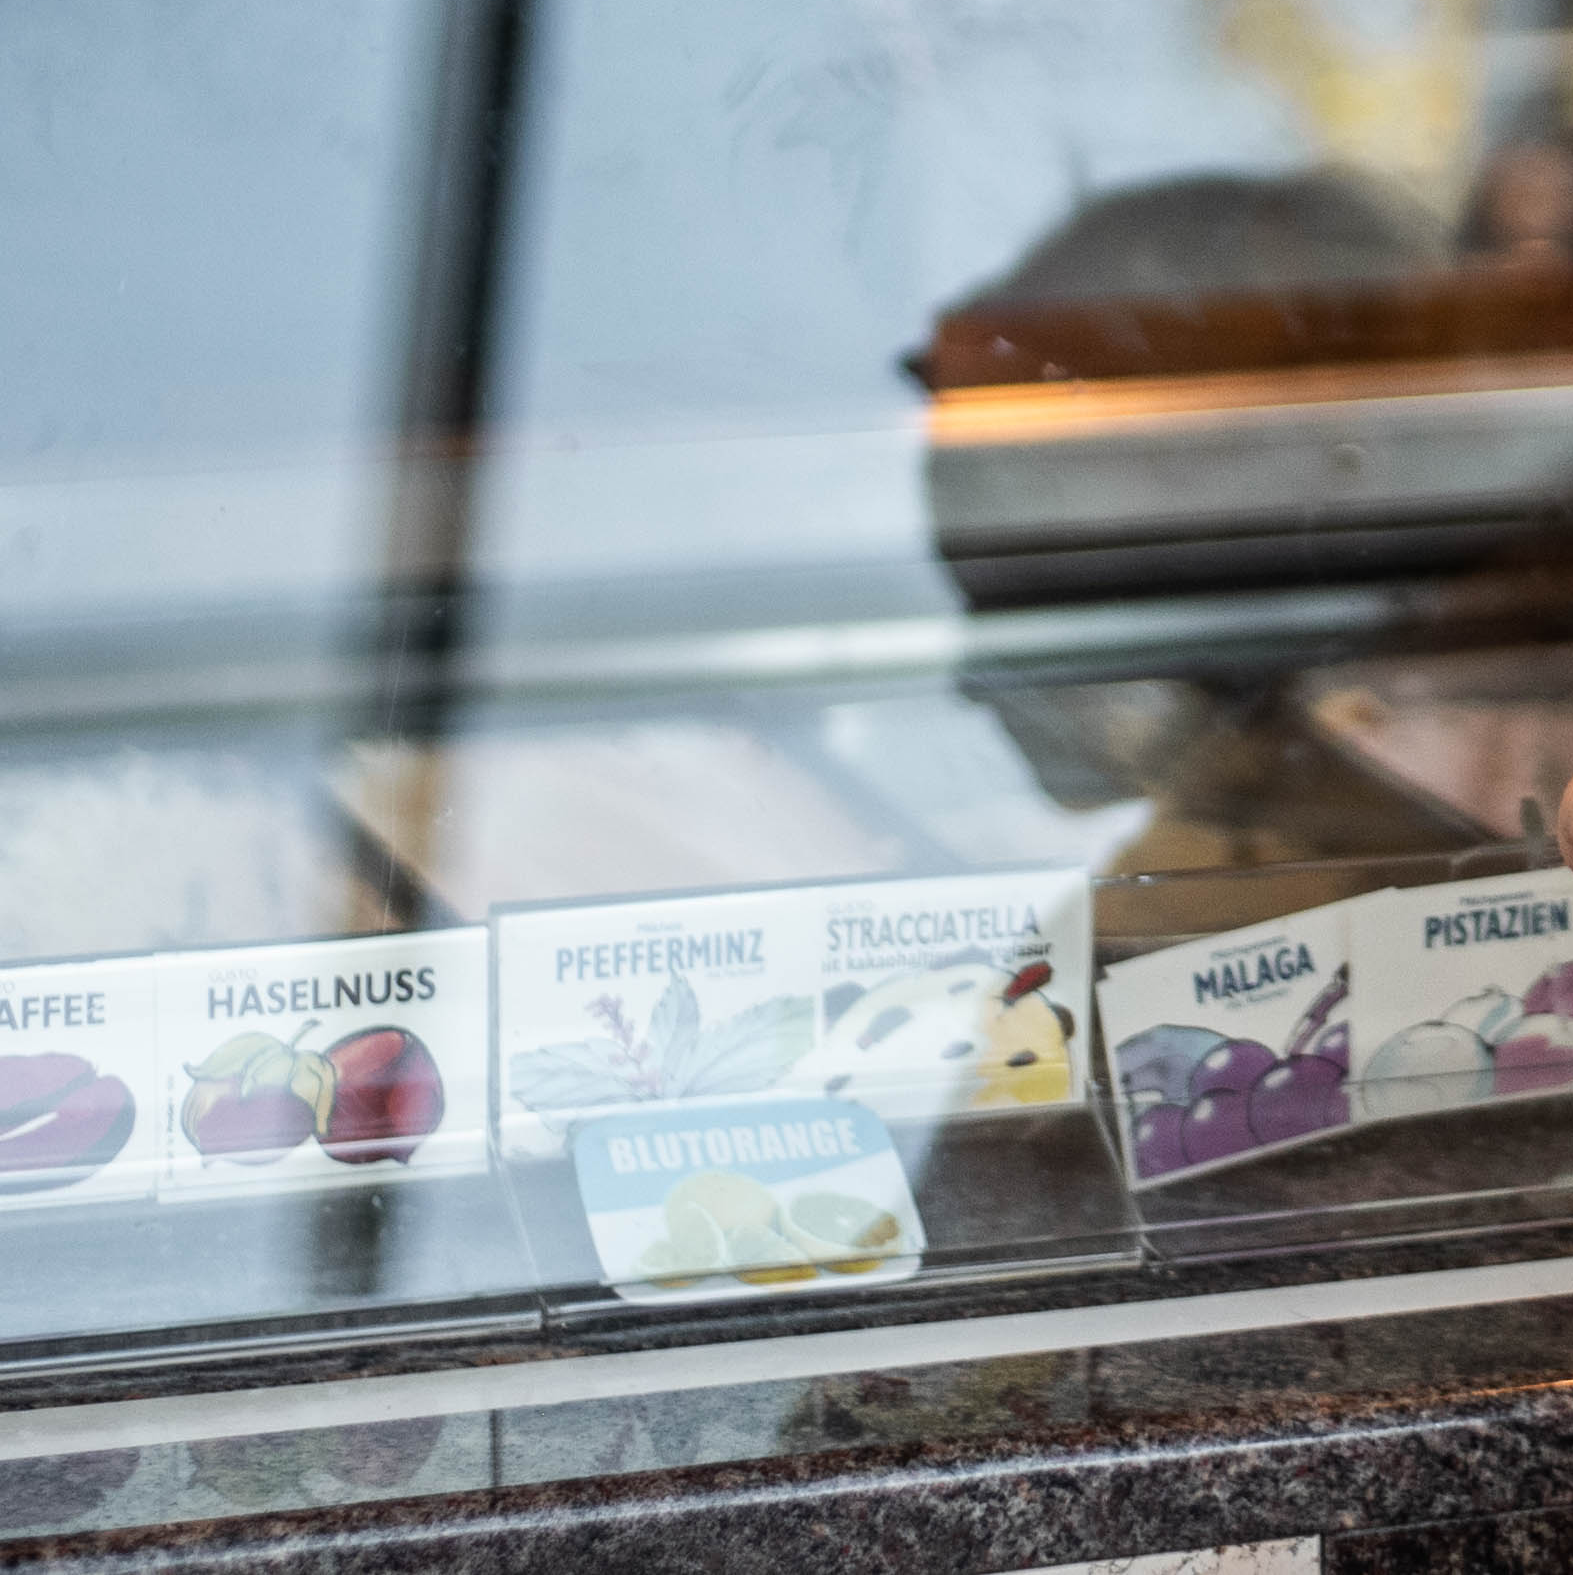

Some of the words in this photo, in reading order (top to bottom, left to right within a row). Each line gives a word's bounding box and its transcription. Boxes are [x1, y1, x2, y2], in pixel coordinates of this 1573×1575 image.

[826, 903, 1042, 952] STRACCIATELLA
[1423, 897, 1571, 950] PISTAZIEN
[555, 927, 767, 984] PFEFFERMINZ
[1192, 941, 1316, 1005] MALAGA
[207, 966, 438, 1021] HASELNUSS
[608, 1117, 862, 1174] BLUTORANGE
